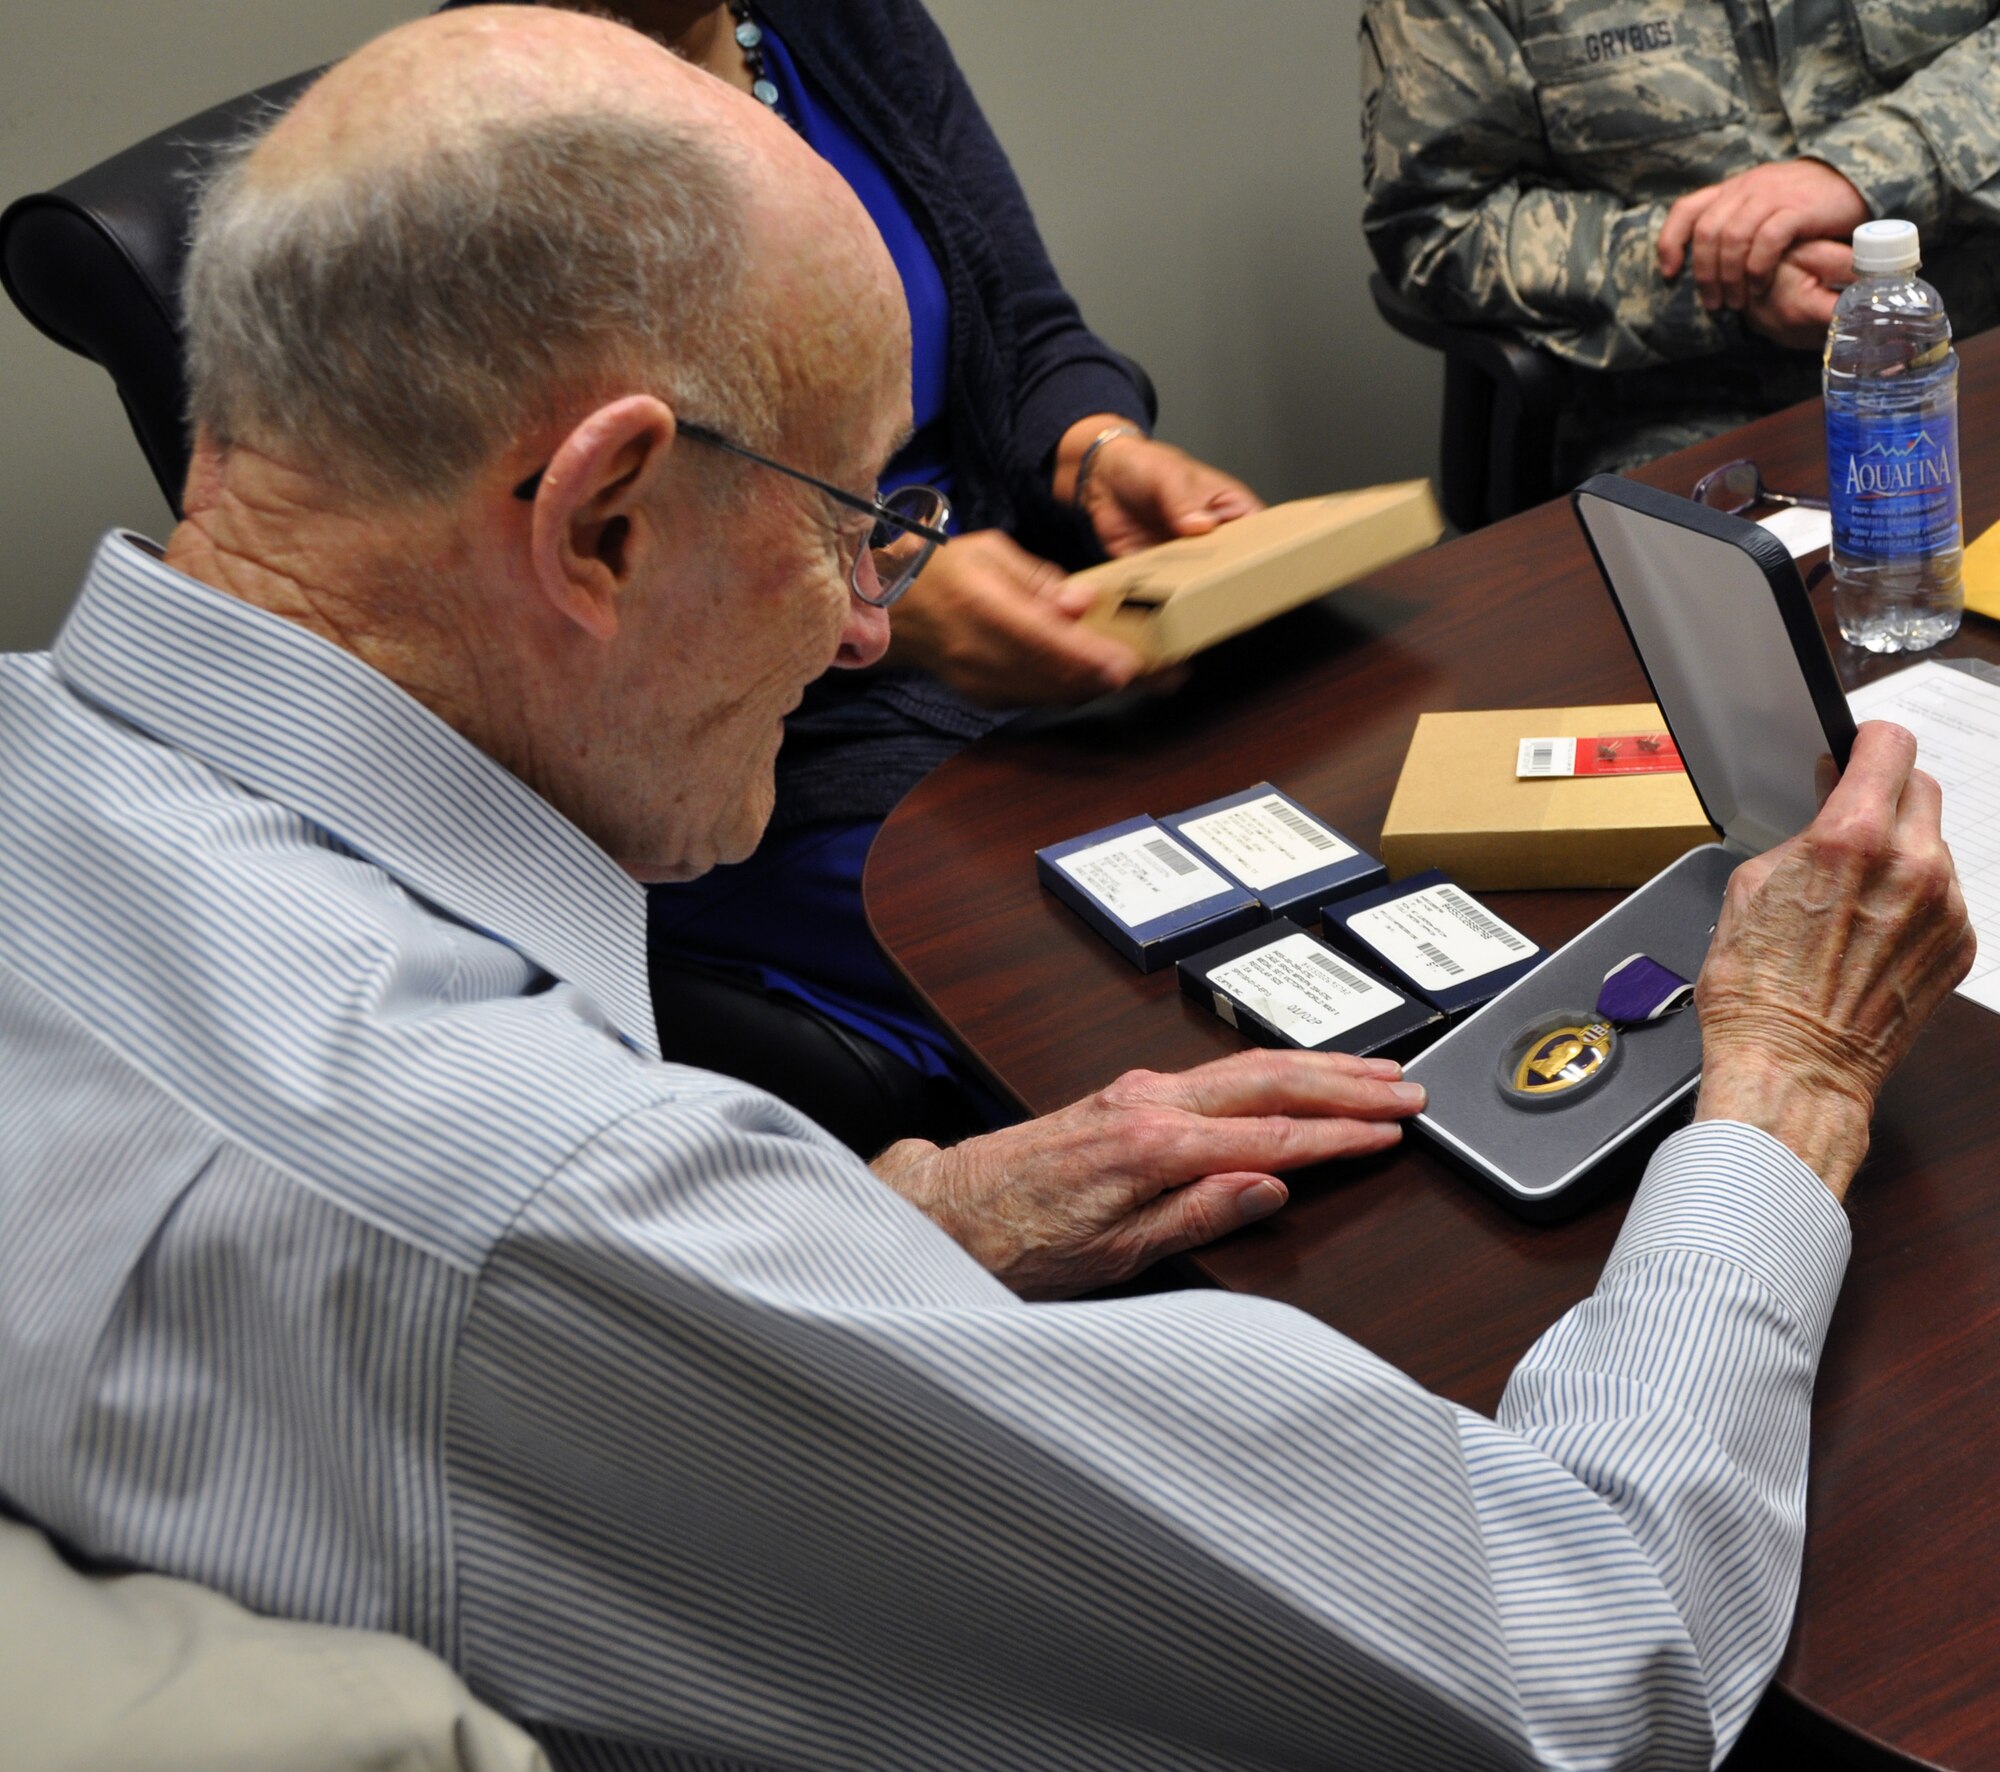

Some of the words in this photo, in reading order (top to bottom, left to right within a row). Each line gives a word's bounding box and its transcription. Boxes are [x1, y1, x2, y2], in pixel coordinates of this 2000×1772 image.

[1585, 20, 1672, 62] GRYBOS
[1846, 446, 1951, 496] AQUAFINA
[1249, 960, 1272, 977] REGULAR
[1270, 976, 1283, 986] SIZE
[1256, 957, 1272, 969] MEDAL
[1322, 1003, 1336, 1012] WAR
